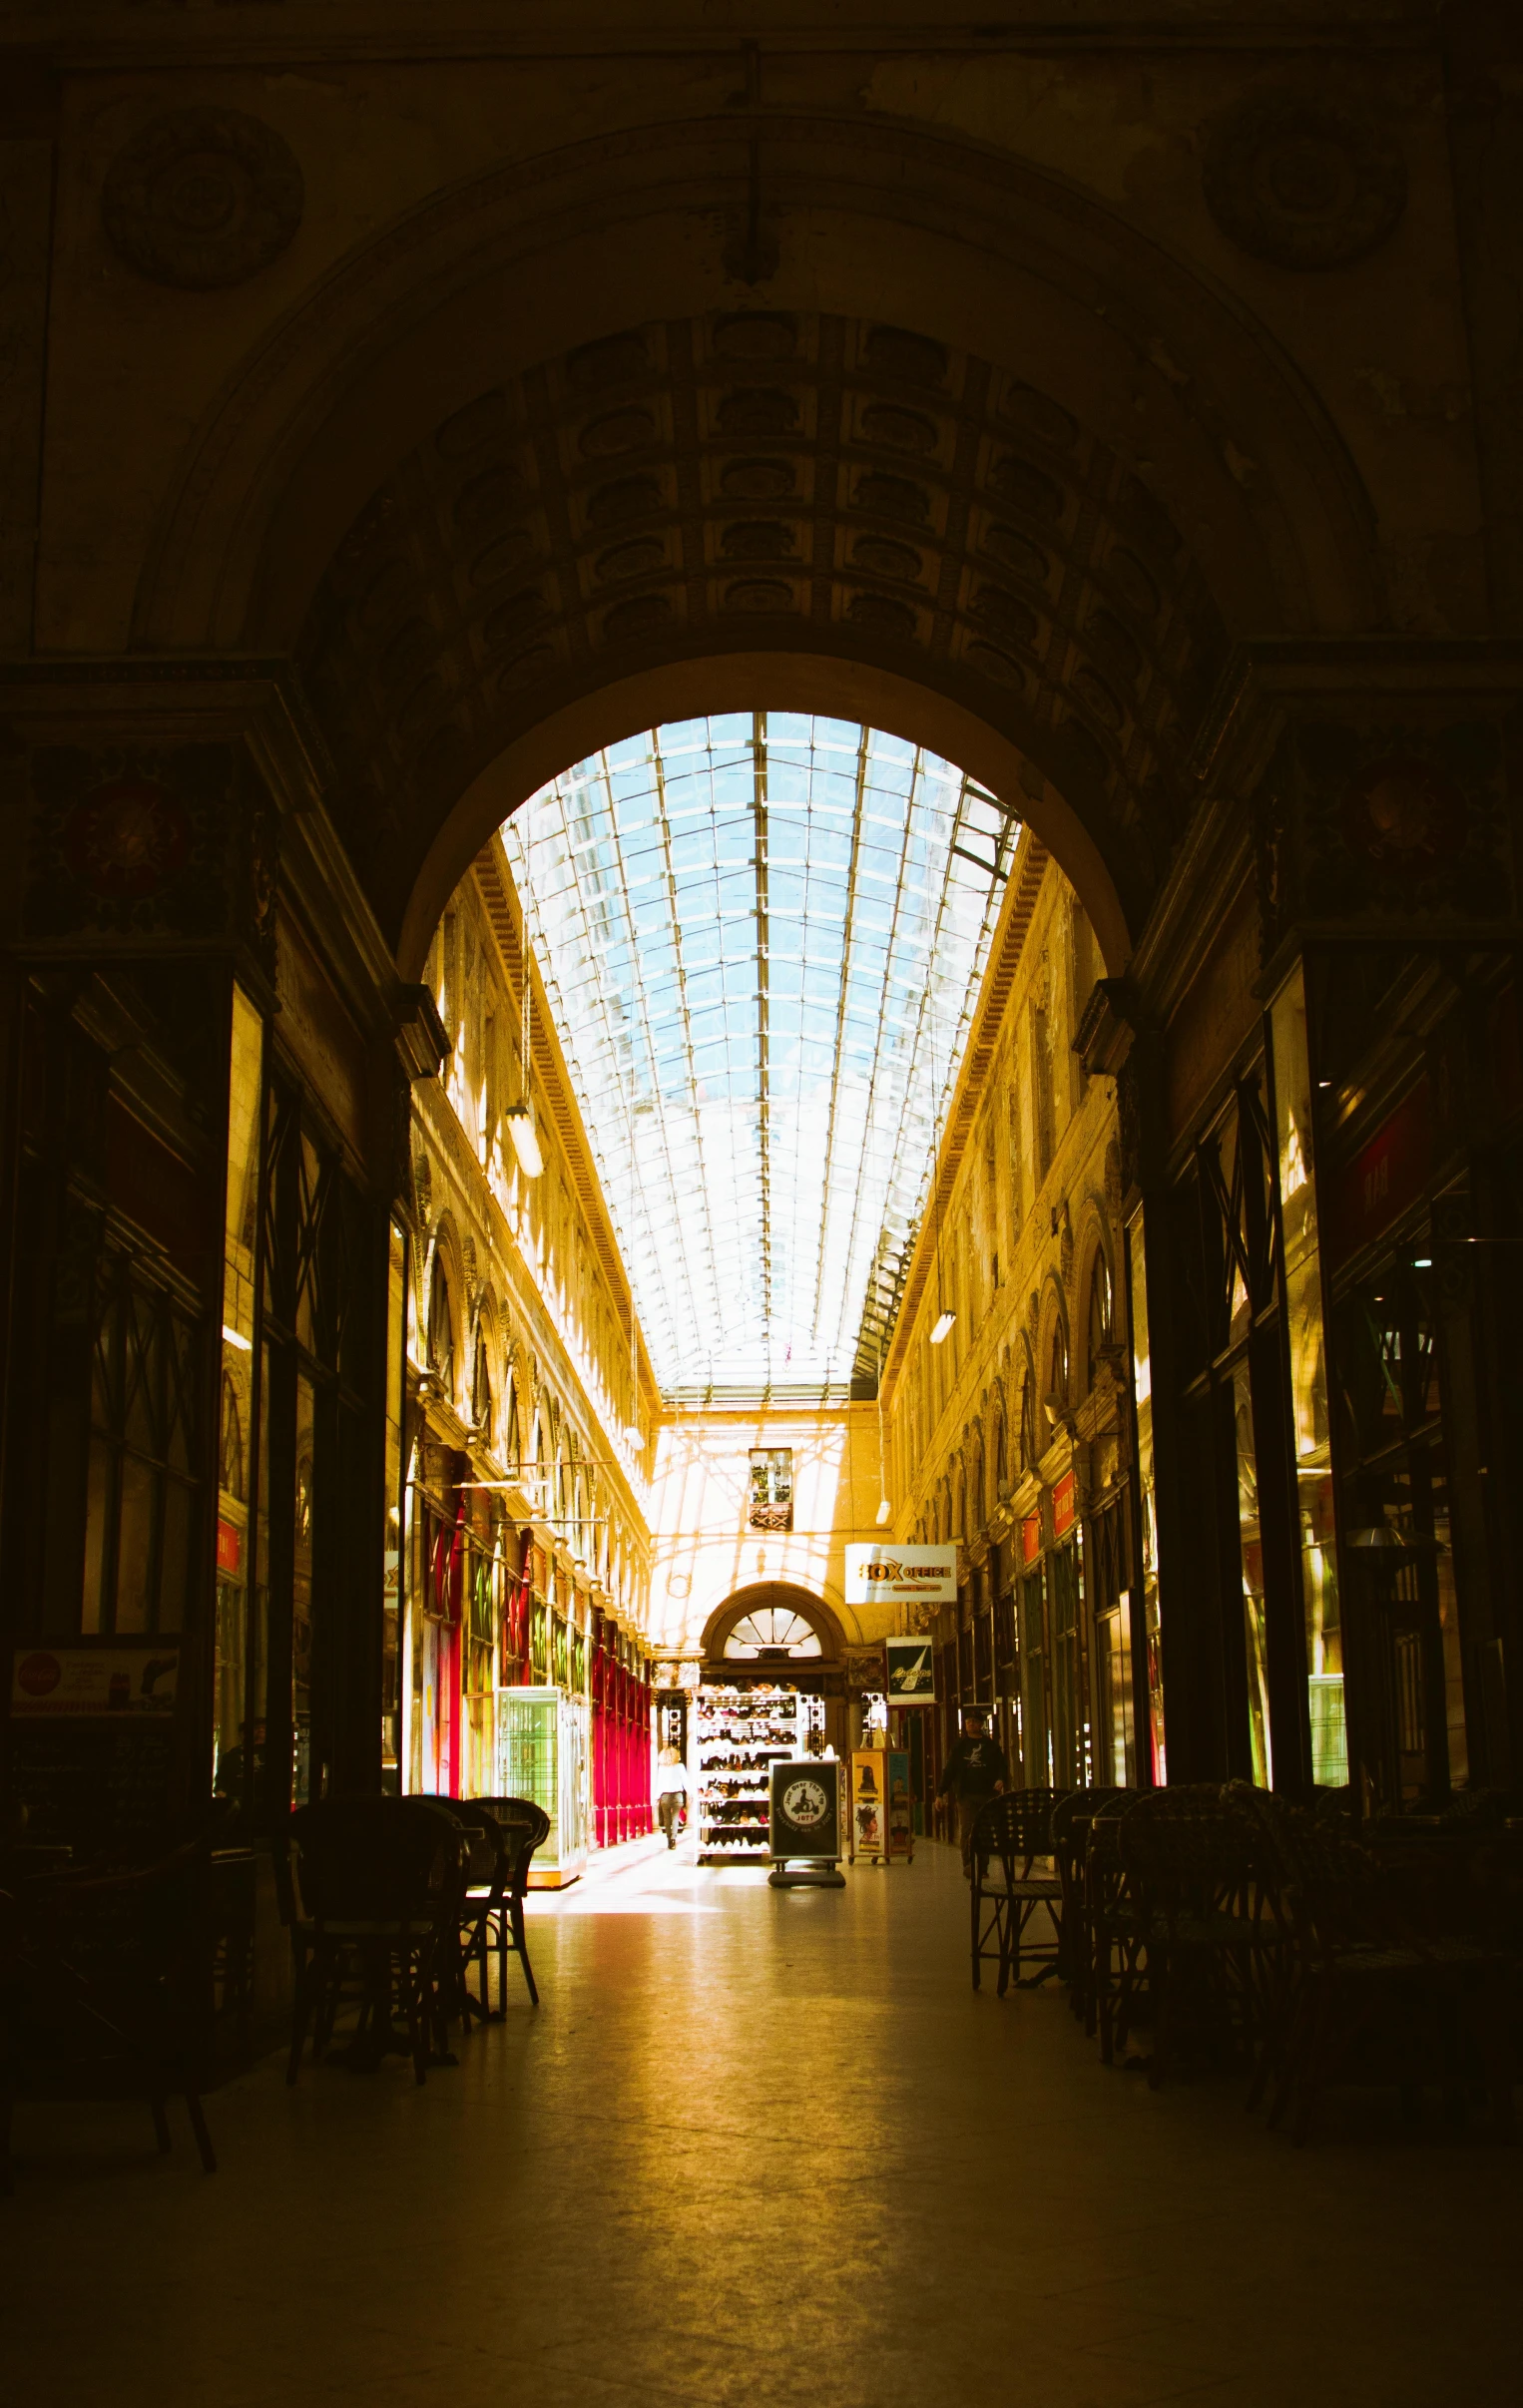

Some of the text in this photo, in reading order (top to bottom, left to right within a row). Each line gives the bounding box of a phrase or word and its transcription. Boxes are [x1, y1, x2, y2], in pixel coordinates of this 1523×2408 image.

[903, 1566, 952, 1579] OFFICE
[791, 1782, 806, 1791] Over
[809, 1782, 819, 1792] The
